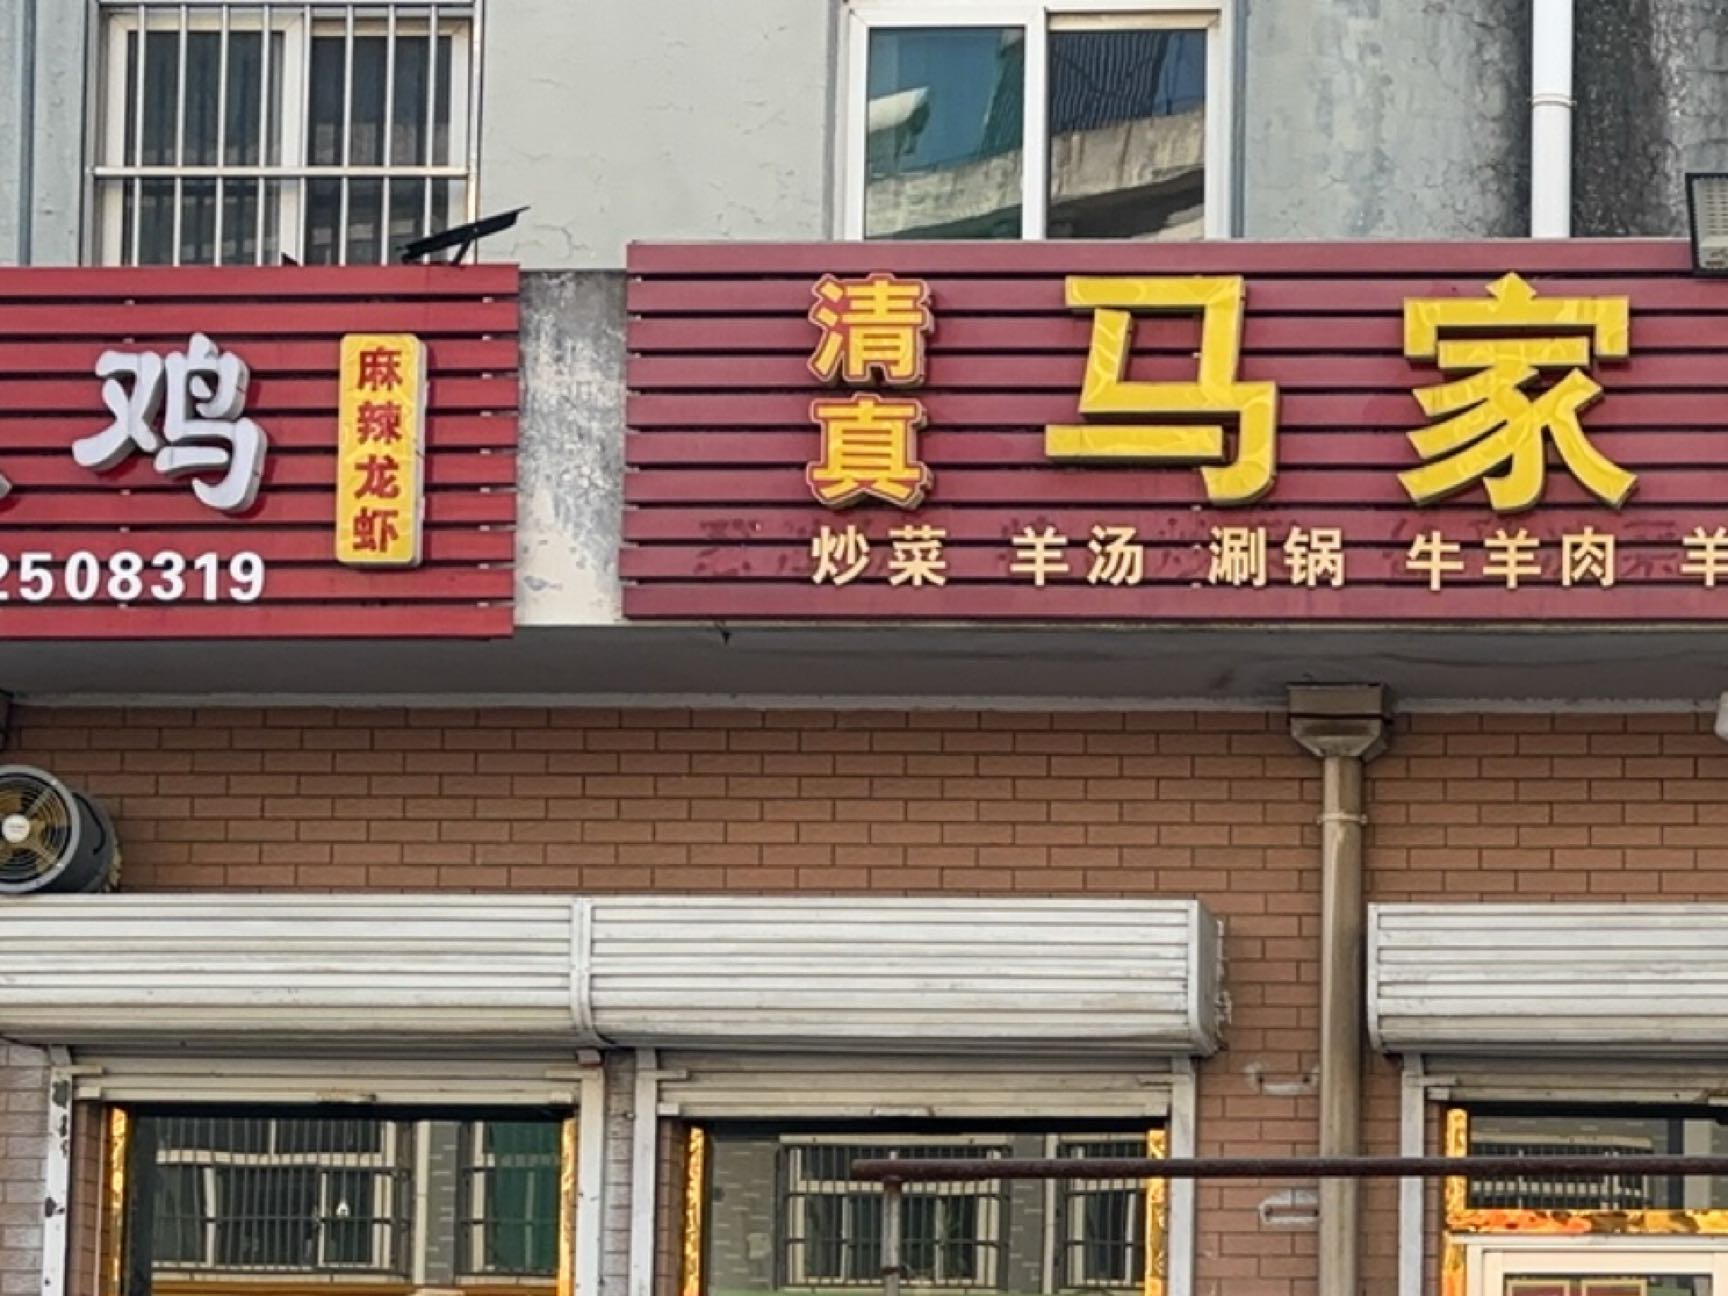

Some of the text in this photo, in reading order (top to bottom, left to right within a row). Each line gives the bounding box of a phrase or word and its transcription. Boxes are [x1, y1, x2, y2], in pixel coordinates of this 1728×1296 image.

[72, 332, 268, 514] 鸡
[352, 346, 403, 554] 麻辣龙虾
[806, 273, 934, 510] 清真
[0, 551, 265, 602] 508319
[810, 525, 947, 587] 炒菜
[1010, 525, 1145, 587] 羊汤
[1207, 526, 1344, 588] 涮锅
[1405, 526, 1617, 591] 牛羊肉
